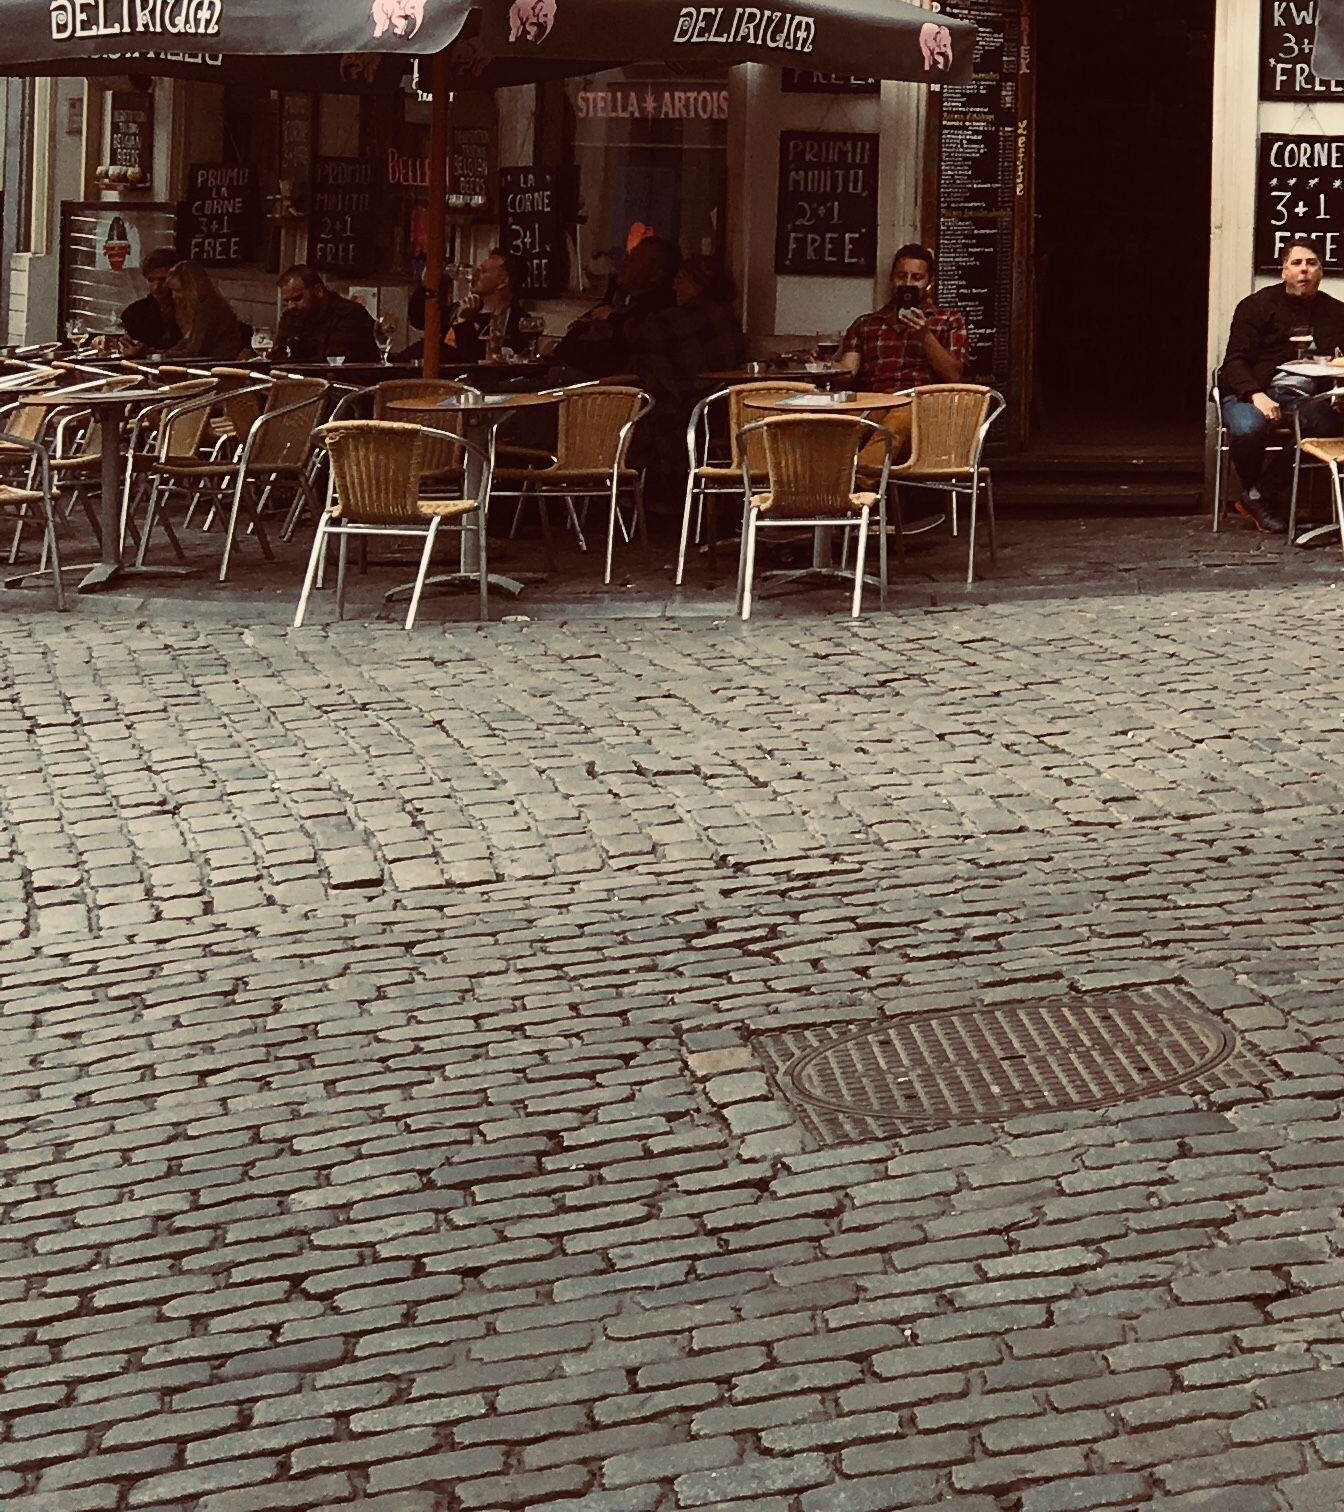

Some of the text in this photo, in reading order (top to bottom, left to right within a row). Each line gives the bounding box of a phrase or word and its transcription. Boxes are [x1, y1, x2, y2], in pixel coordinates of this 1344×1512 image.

[673, 7, 816, 53] DELIRIUM
[576, 89, 729, 120] STELLA ARTOIS
[787, 140, 871, 164] PROMO
[519, 173, 536, 189] LA
[191, 197, 244, 216] CORNE
[507, 190, 551, 213] CORNE
[190, 237, 241, 261] FREE
[509, 222, 541, 256] 3+1
[786, 232, 861, 264] FREE
[1273, 231, 1340, 263] FE
